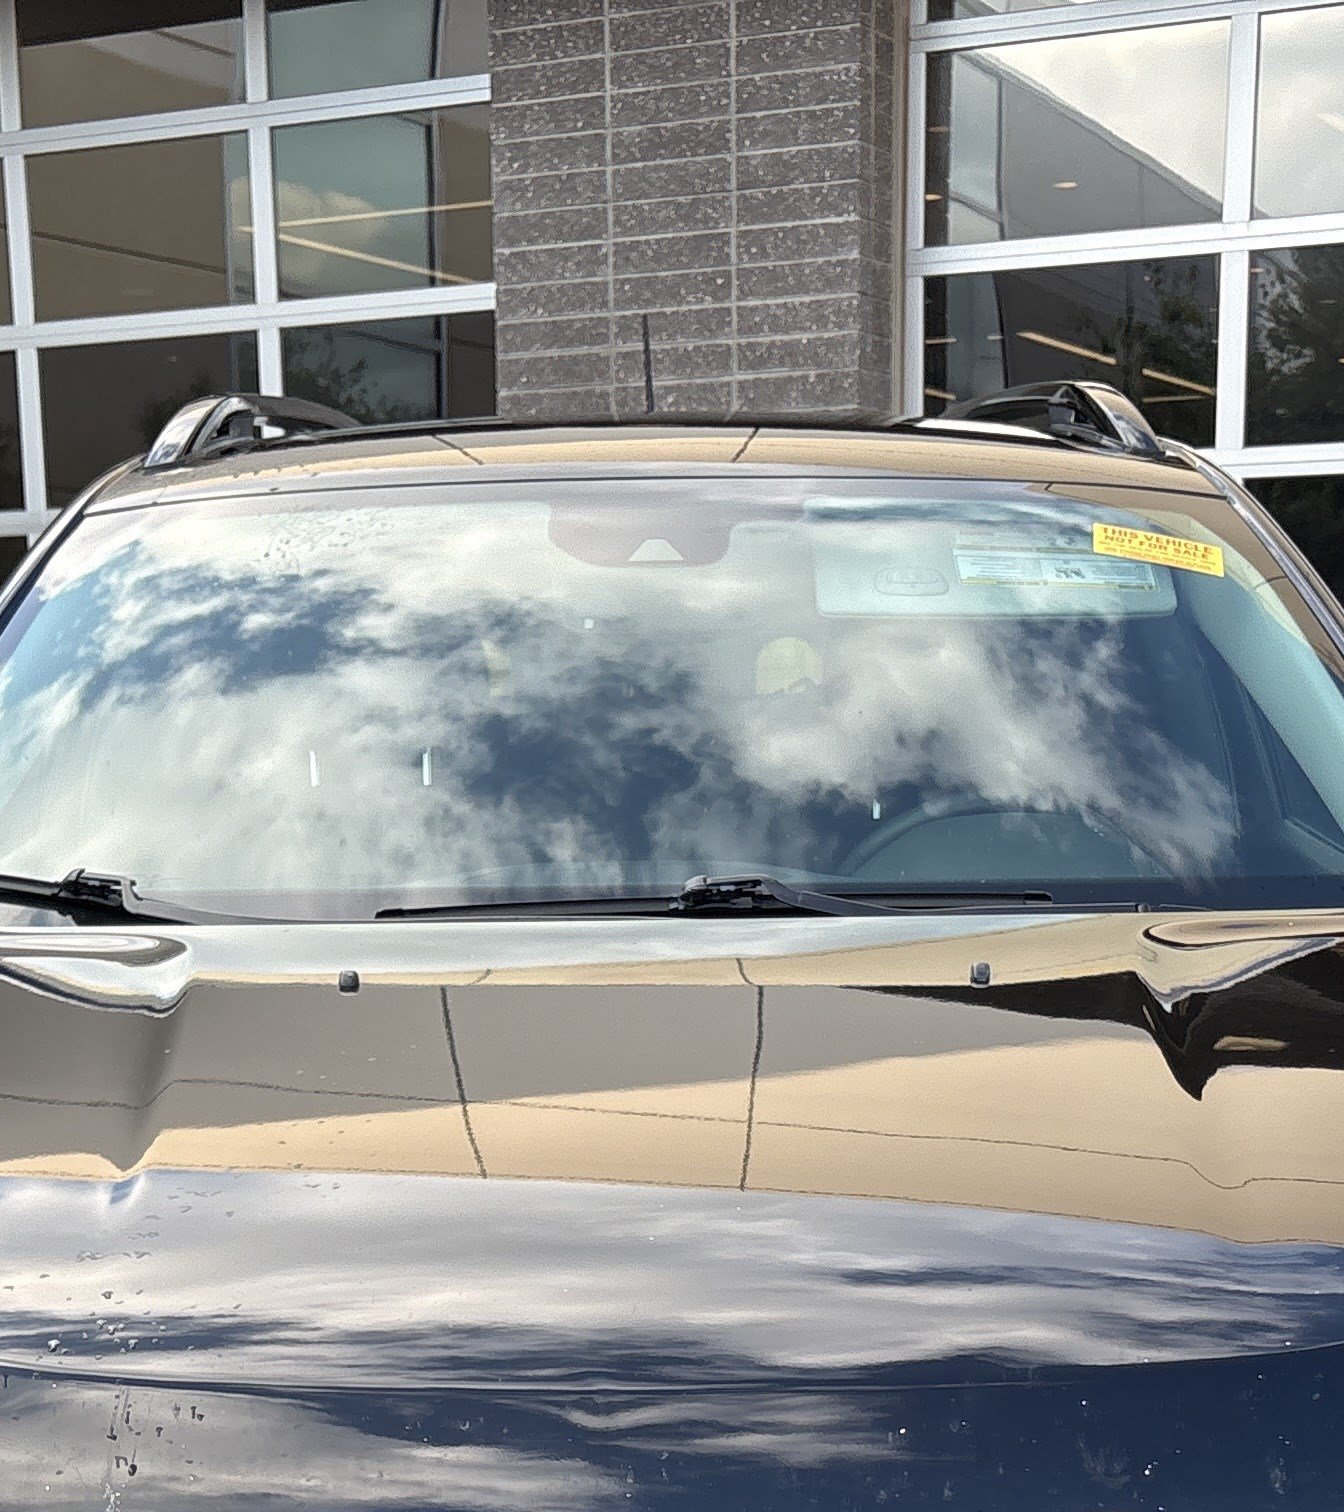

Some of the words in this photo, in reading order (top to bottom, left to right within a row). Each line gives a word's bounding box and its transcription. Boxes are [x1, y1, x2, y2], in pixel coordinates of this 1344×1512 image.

[1102, 526, 1139, 540] THIS
[1144, 534, 1213, 555] VEHICLE
[1104, 534, 1133, 545] NOT
[1138, 540, 1168, 552] FOR
[1173, 547, 1209, 560] SALE
